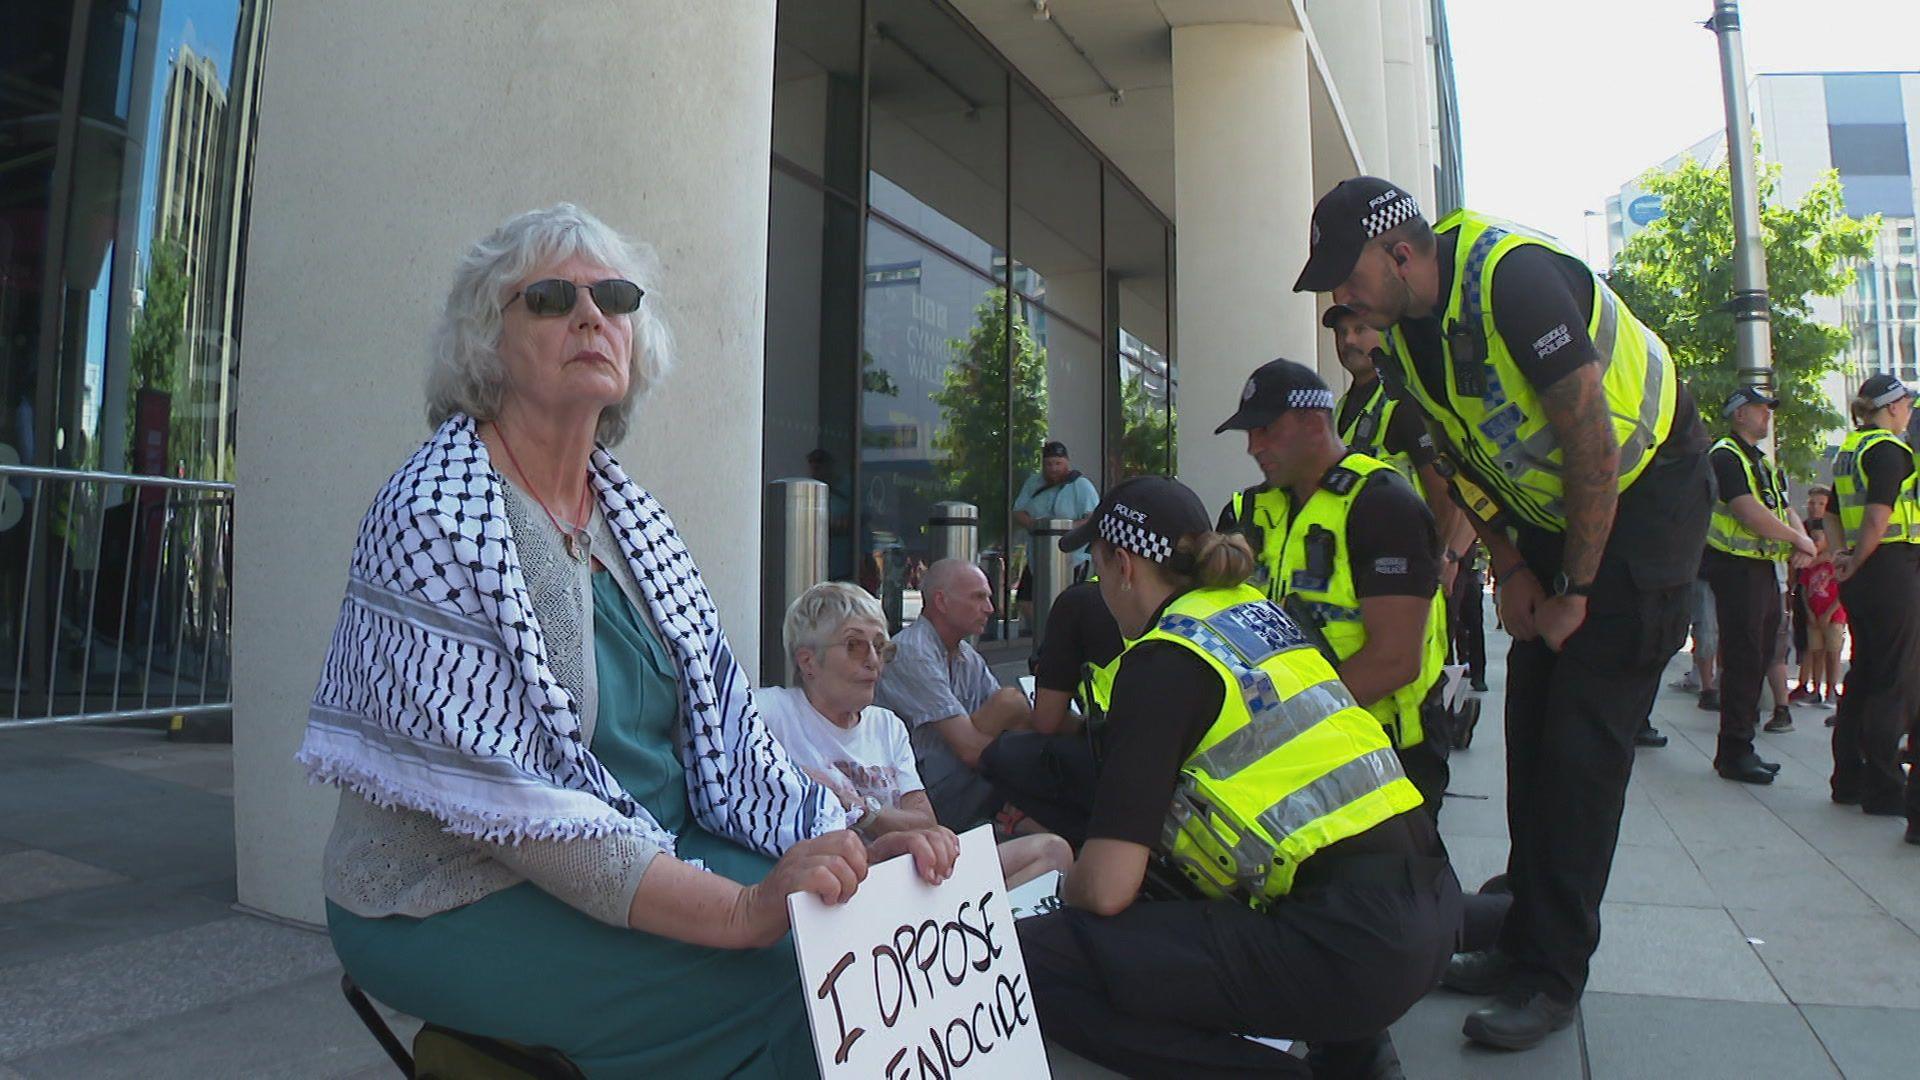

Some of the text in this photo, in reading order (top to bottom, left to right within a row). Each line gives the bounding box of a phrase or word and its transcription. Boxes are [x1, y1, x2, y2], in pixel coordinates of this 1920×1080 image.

[1113, 503, 1148, 524] POLICE
[818, 891, 1003, 1065] I OPPOSE
[885, 973, 1030, 1080] ENOCIDE
